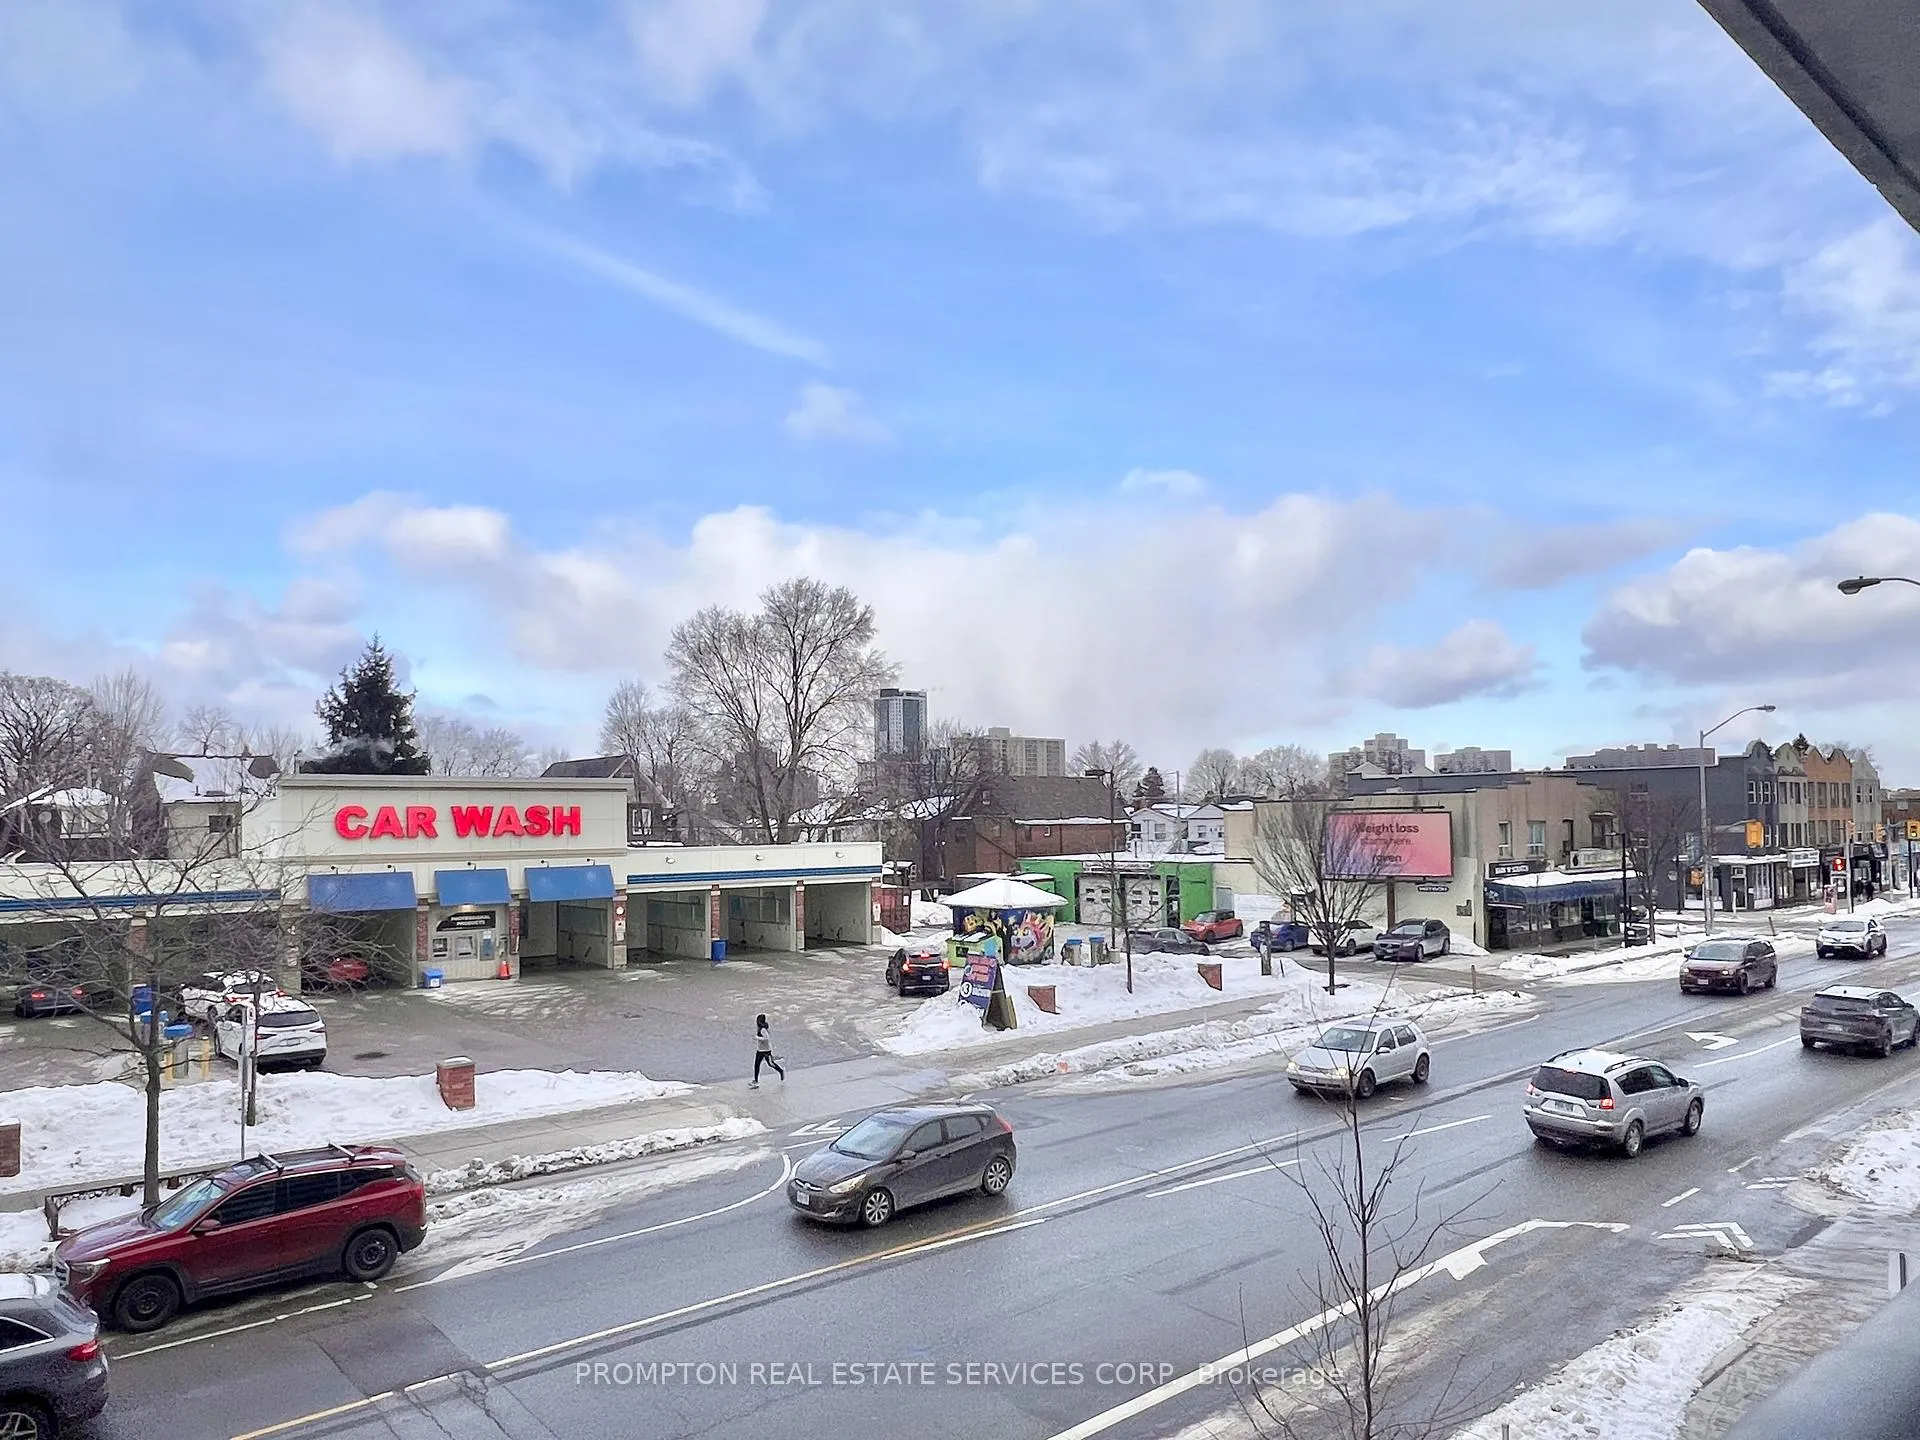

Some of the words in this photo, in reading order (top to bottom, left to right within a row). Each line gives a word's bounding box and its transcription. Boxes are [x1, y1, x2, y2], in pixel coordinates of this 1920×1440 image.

[334, 805, 439, 841] CAR
[450, 805, 582, 838] WASH
[1355, 822, 1394, 836] Weight
[1396, 822, 1420, 833] loss
